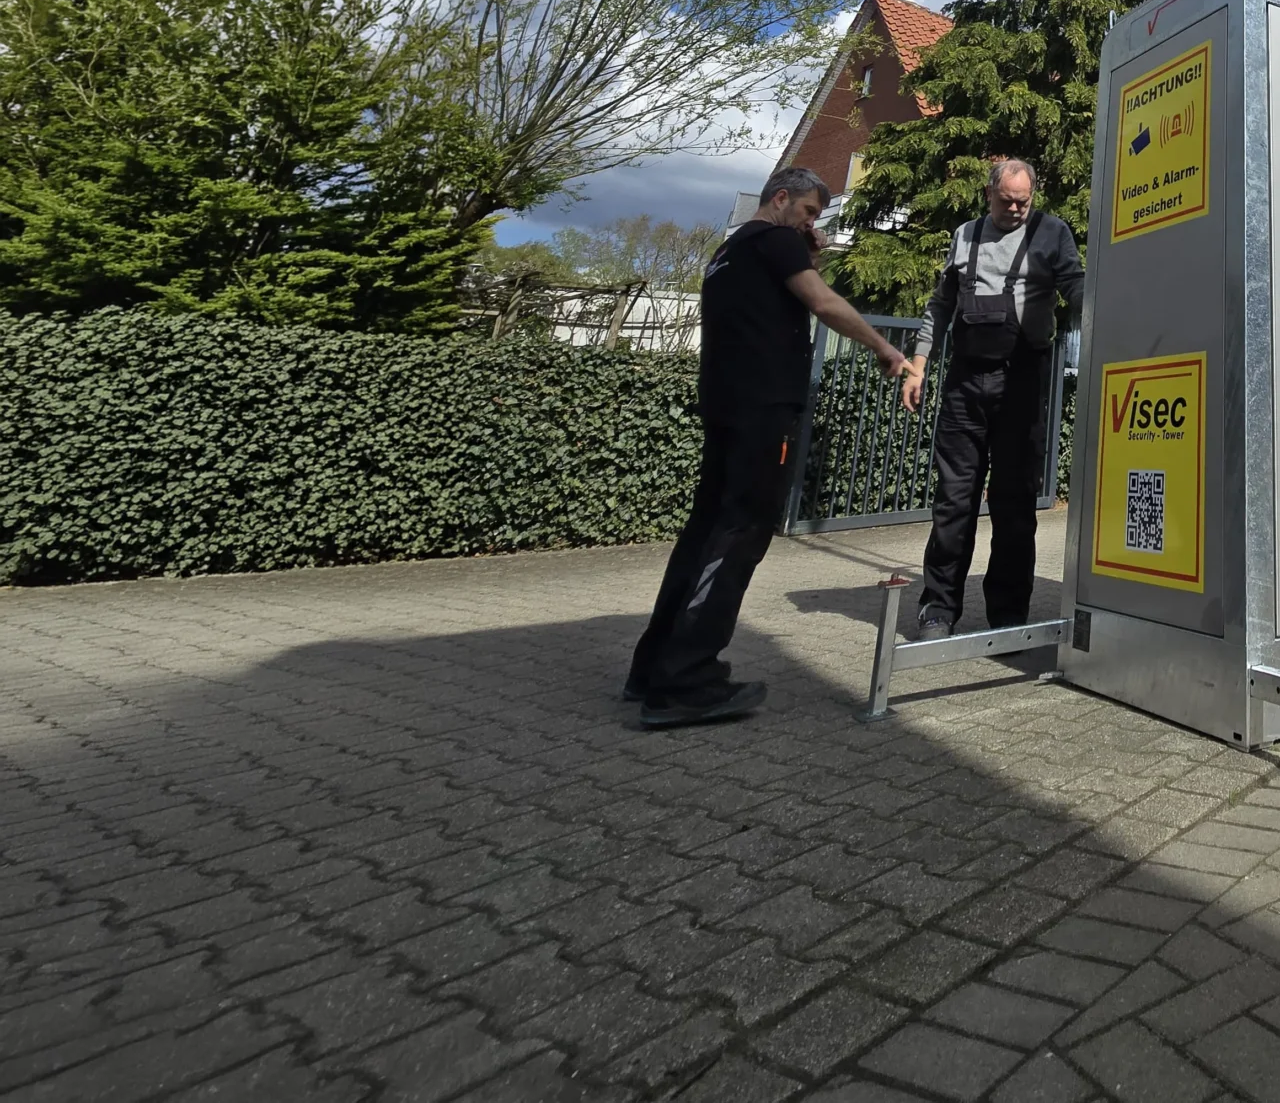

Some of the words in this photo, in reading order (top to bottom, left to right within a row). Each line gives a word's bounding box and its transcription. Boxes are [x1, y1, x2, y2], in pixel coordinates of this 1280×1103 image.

[1126, 63, 1202, 113] !!ACHTUNG!!
[1121, 181, 1149, 201] Video
[1152, 176, 1160, 190] &
[1163, 165, 1199, 186] Alarm-
[1133, 193, 1182, 223] gesichert
[1111, 372, 1192, 433] Visec
[1128, 430, 1156, 443] Security
[1162, 429, 1185, 440] Tower
